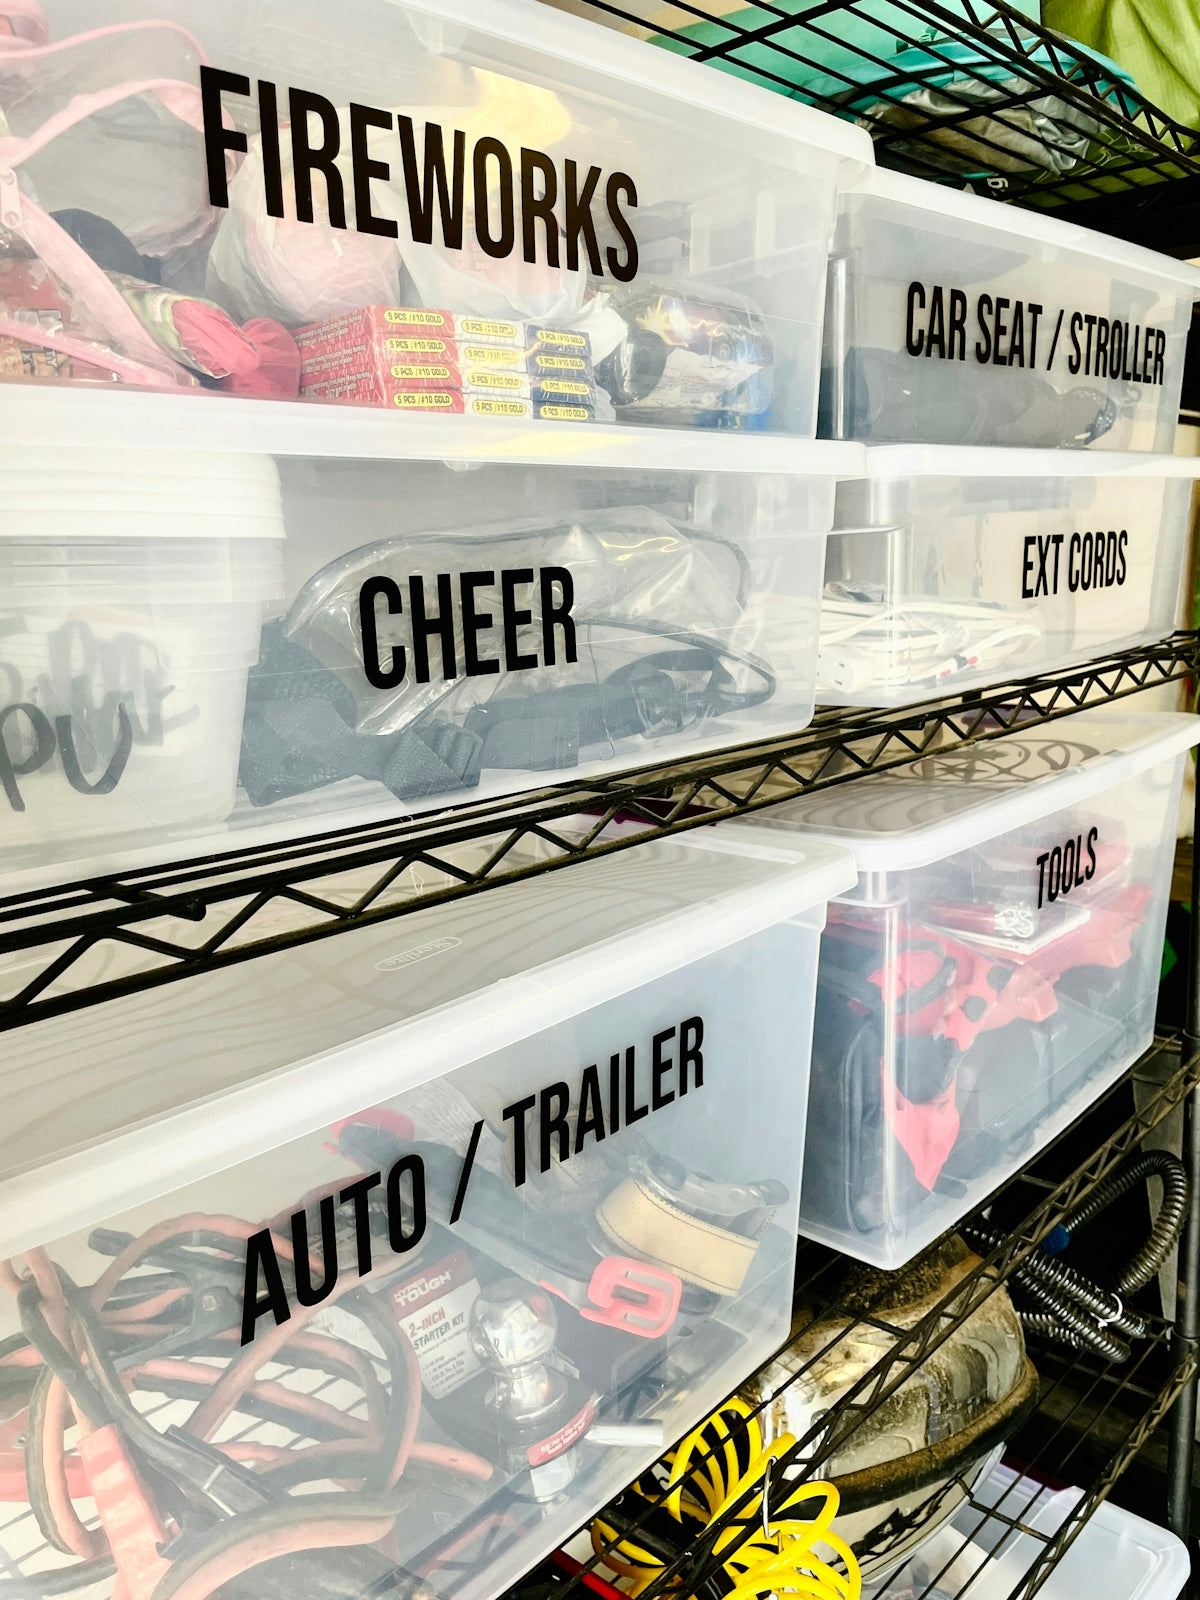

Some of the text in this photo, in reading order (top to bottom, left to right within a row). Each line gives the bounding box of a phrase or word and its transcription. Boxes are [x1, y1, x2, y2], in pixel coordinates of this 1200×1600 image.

[200, 64, 639, 283] FIREWORKS
[394, 312, 407, 321] PCS
[425, 314, 442, 323] GOLD
[906, 281, 1166, 386] CAR SEAT / STROLLER
[395, 340, 409, 349] PCS
[427, 342, 443, 350] GOLD
[400, 368, 413, 376] PCS
[431, 368, 448, 376] GOLD
[476, 375, 488, 384] PCS
[504, 378, 519, 386] GOLD
[403, 395, 416, 404] PCS
[434, 395, 450, 404] GOLD
[481, 402, 493, 411] PCS
[509, 404, 523, 413] GOLD
[1021, 529, 1128, 599] EXT CORDS
[359, 566, 578, 690] CHEER
[1036, 826, 1098, 910] TOOLS
[240, 1153, 427, 1347] AUTO
[449, 1119, 485, 1226] /
[502, 1015, 704, 1188] TRAILER
[395, 1270, 452, 1307] TOUGH
[409, 1306, 446, 1338] 2-INCH
[413, 1321, 451, 1350] STARTER
[451, 1311, 465, 1327] KIT
